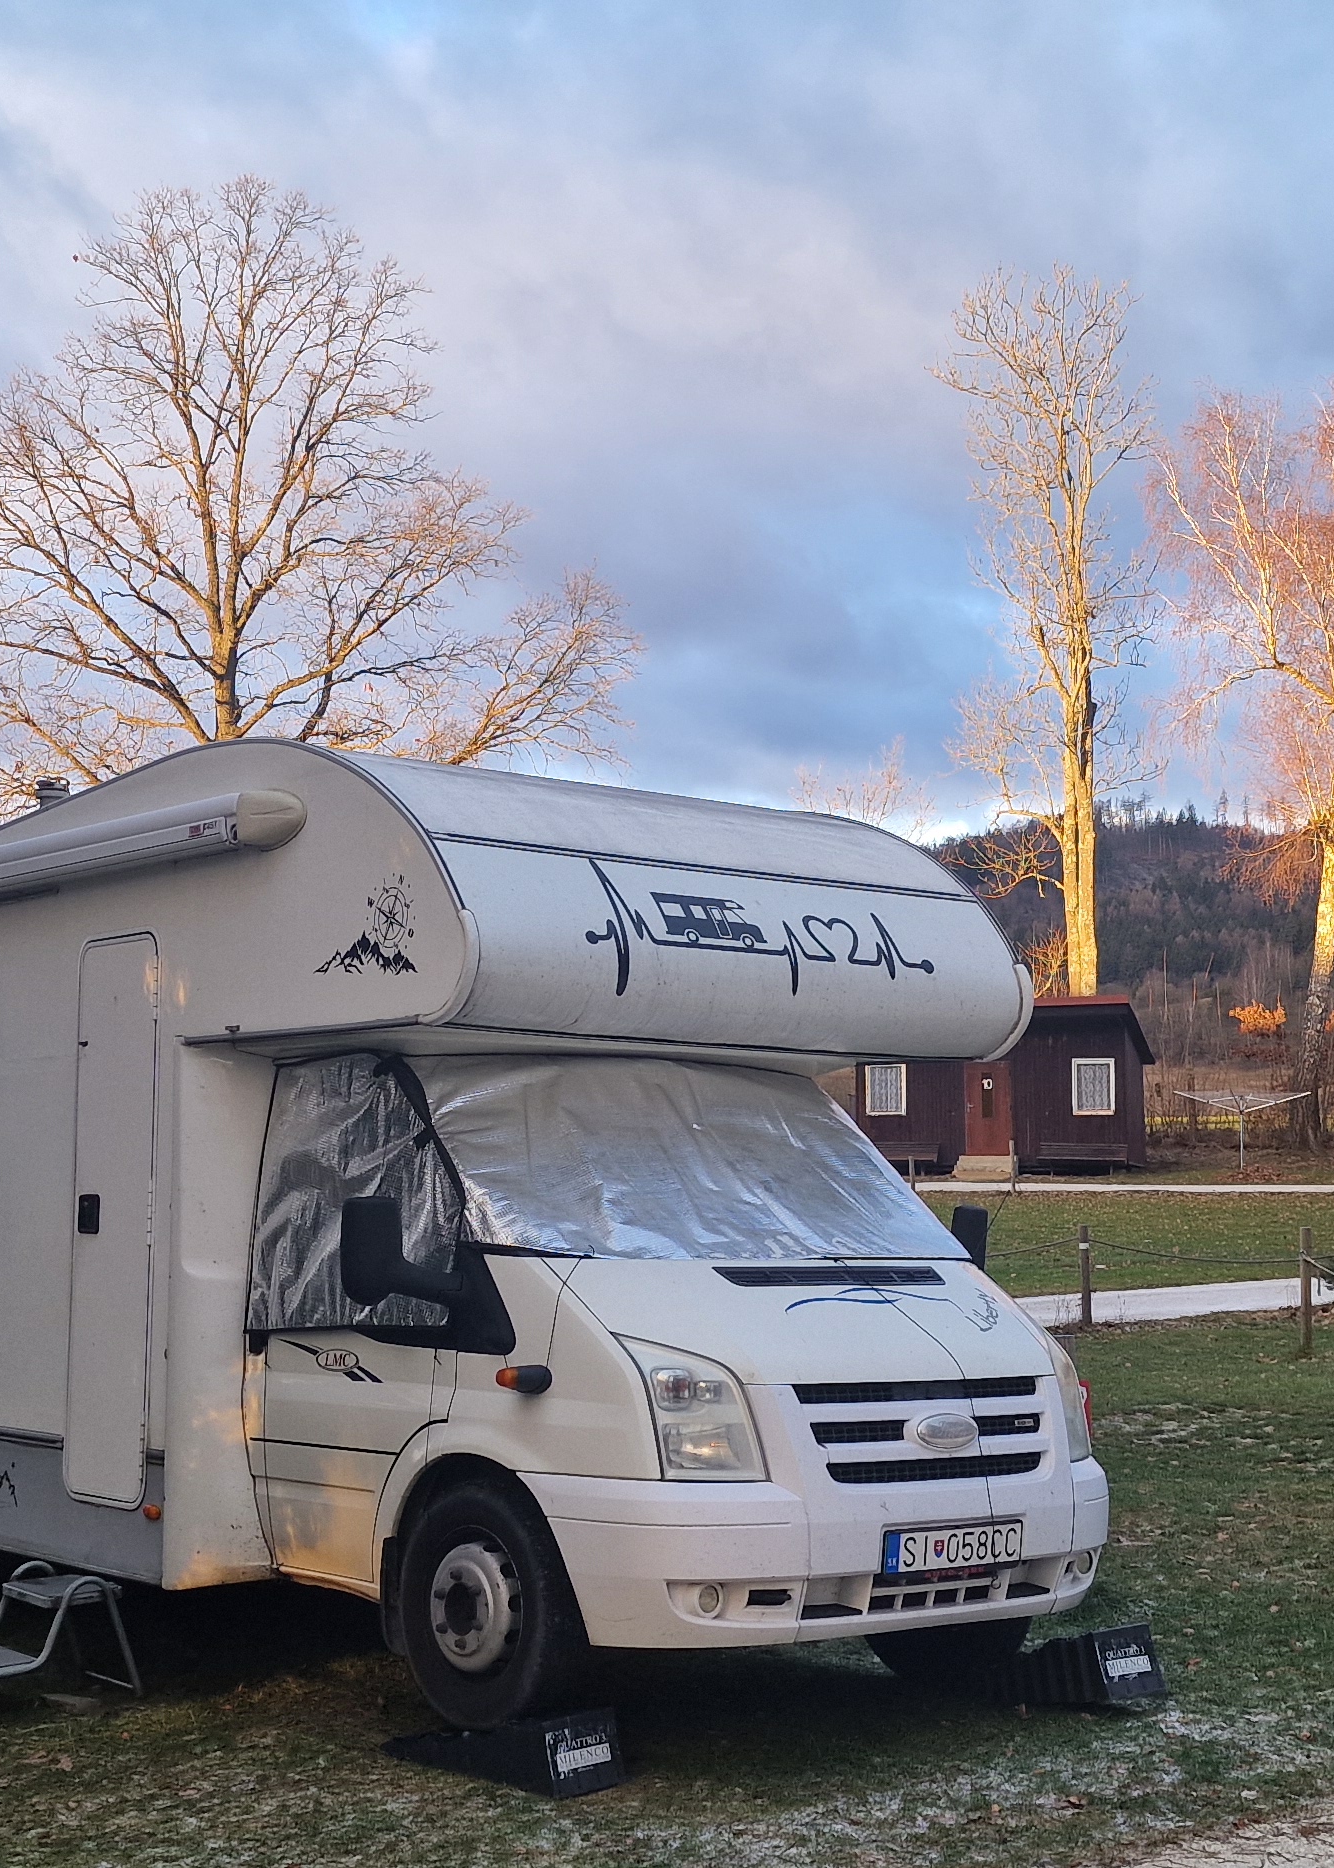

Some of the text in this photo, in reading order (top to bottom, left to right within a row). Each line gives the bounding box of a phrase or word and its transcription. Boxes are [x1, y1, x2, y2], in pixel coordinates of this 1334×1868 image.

[981, 1078, 993, 1090] 10
[324, 1352, 351, 1367] LMC
[902, 1527, 1018, 1568] SI 058CC
[887, 1556, 897, 1567] SK
[1107, 1656, 1149, 1669] MILENCO
[558, 1745, 609, 1764] MILENCO
